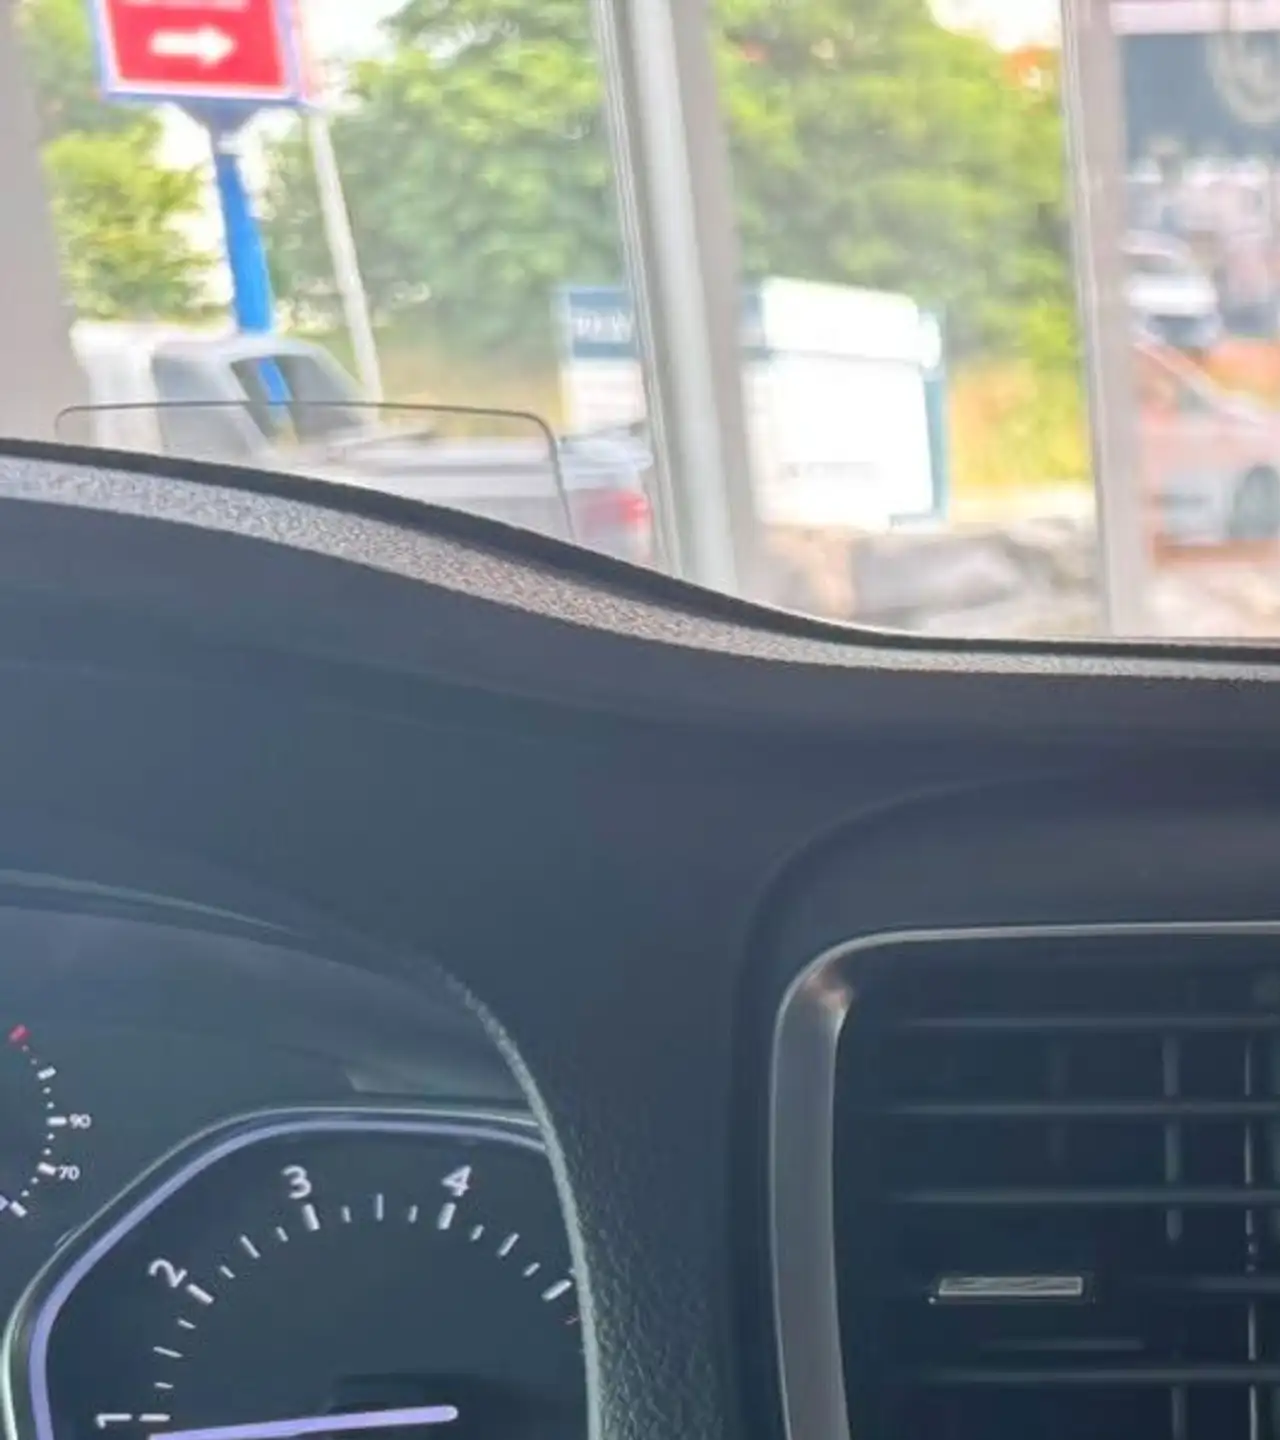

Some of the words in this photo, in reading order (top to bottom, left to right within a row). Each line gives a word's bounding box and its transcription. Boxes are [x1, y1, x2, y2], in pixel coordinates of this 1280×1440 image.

[69, 1113, 92, 1129] 90
[58, 1165, 81, 1181] 70
[281, 1164, 312, 1199] 3
[442, 1164, 473, 1197] 4
[148, 1258, 187, 1289] 2
[95, 1413, 132, 1429] 1
